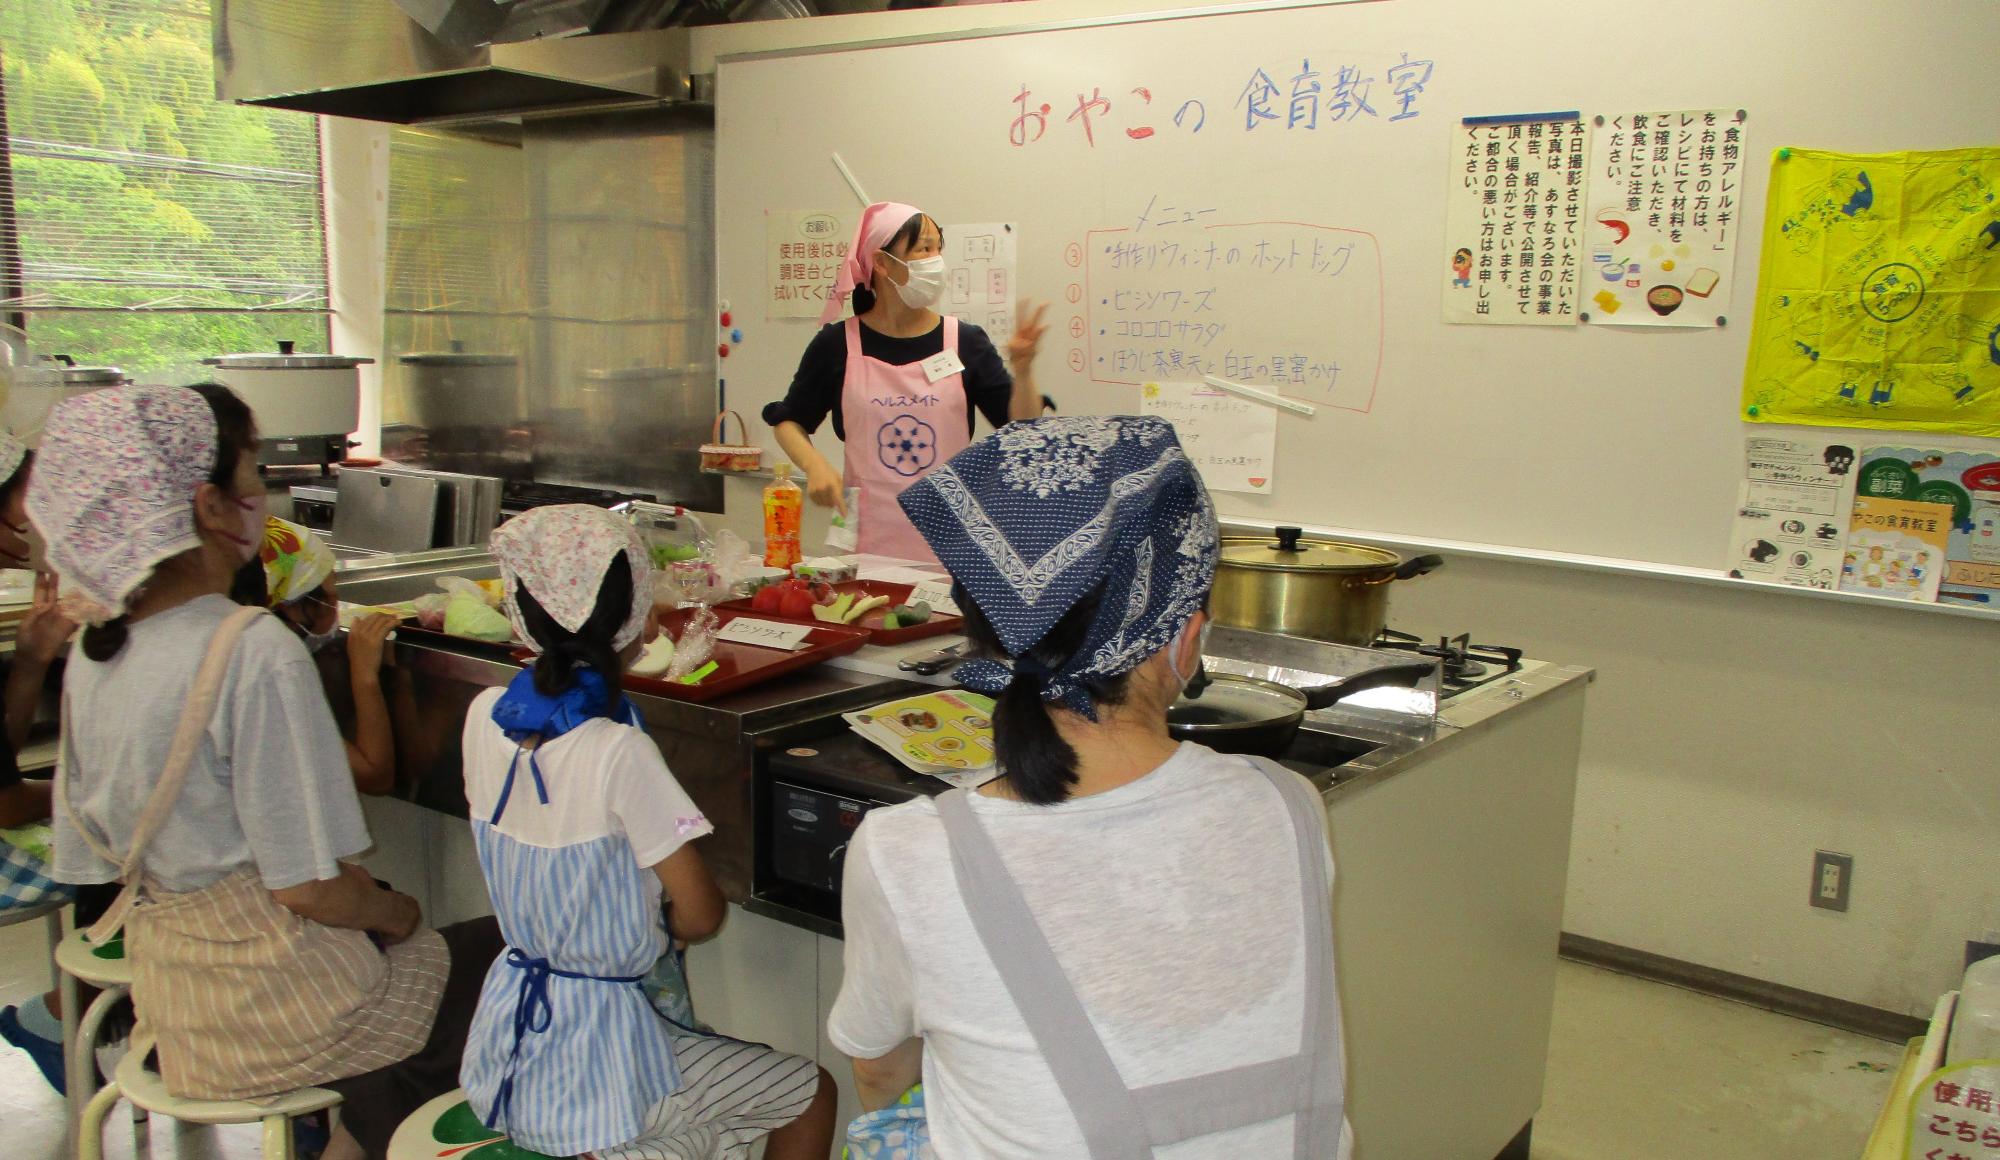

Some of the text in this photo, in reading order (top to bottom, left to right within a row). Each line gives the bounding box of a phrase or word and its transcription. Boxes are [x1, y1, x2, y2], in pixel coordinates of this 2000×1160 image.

[1464, 126, 1480, 195] ください。
[1607, 116, 1624, 186] ください。
[1626, 114, 1648, 212] 飲食にご注意
[1648, 113, 1671, 234] ご確認いただき、
[1669, 113, 1694, 243] レシピにて材料を
[1693, 111, 1716, 234] をお持ちの方は、
[805, 220, 835, 233] お願い
[1135, 194, 1217, 233] メニュー
[1558, 121, 1586, 315] 本日撮影させていただいた
[870, 394, 940, 407] ヘルスメイト
[1870, 478, 1904, 495] 副菜
[1934, 1081, 2000, 1114] 使用
